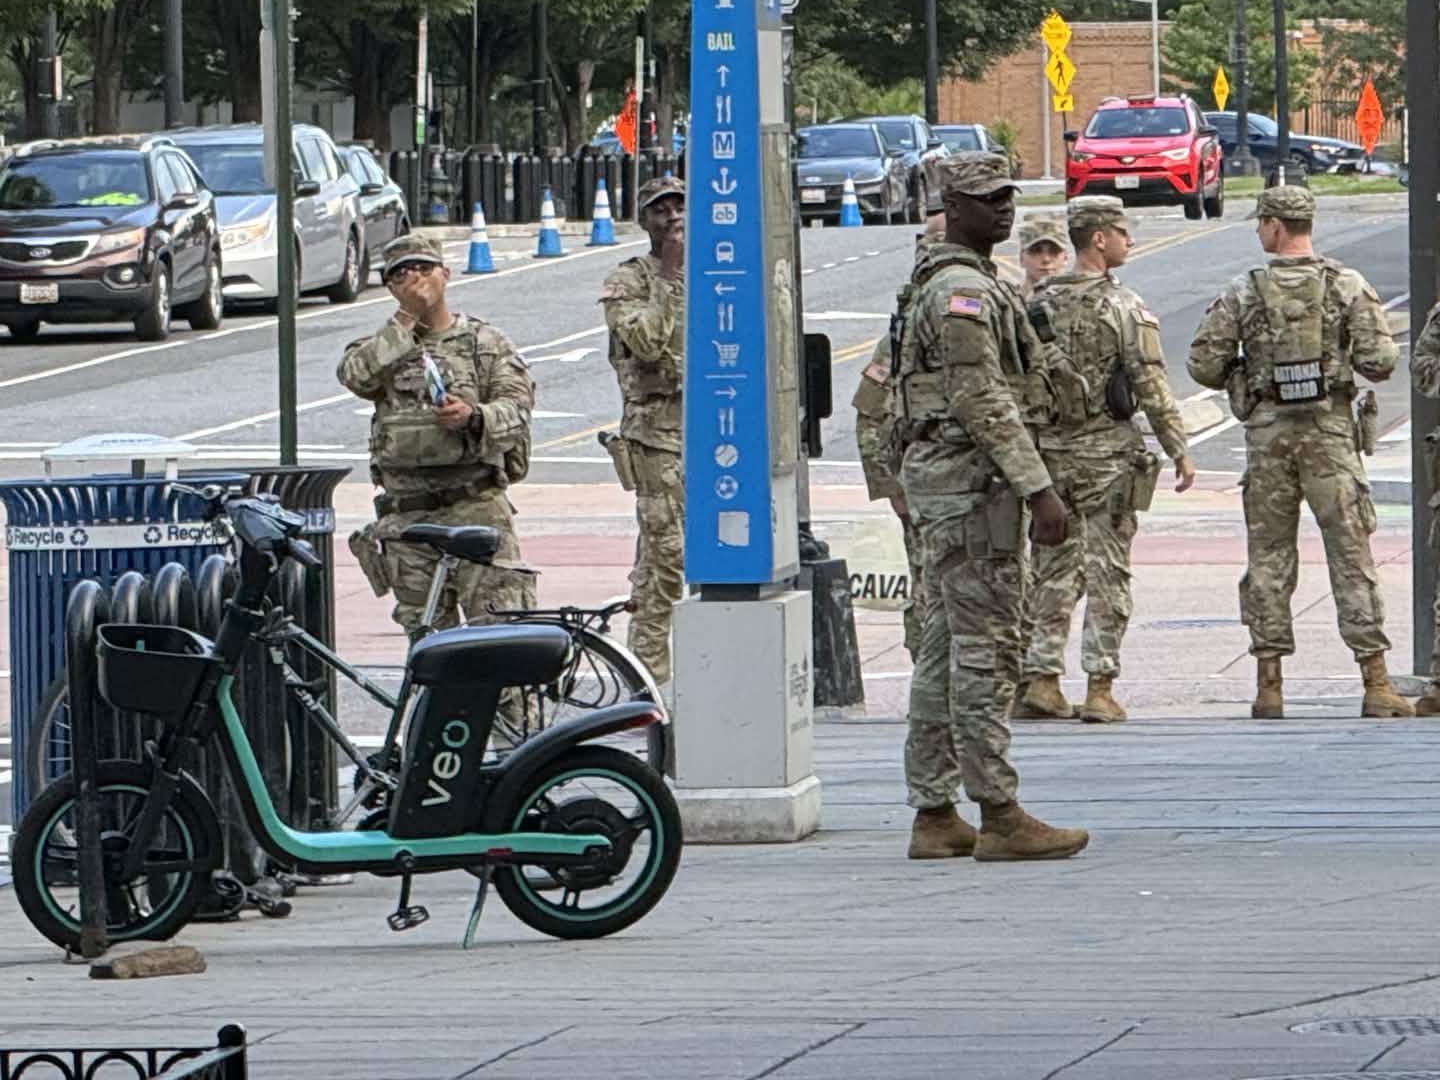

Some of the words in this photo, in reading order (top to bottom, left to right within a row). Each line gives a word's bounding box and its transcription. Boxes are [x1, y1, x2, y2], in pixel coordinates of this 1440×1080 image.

[15, 527, 65, 548] Recycle
[849, 573, 908, 599] CAVA
[421, 719, 470, 807] veo
